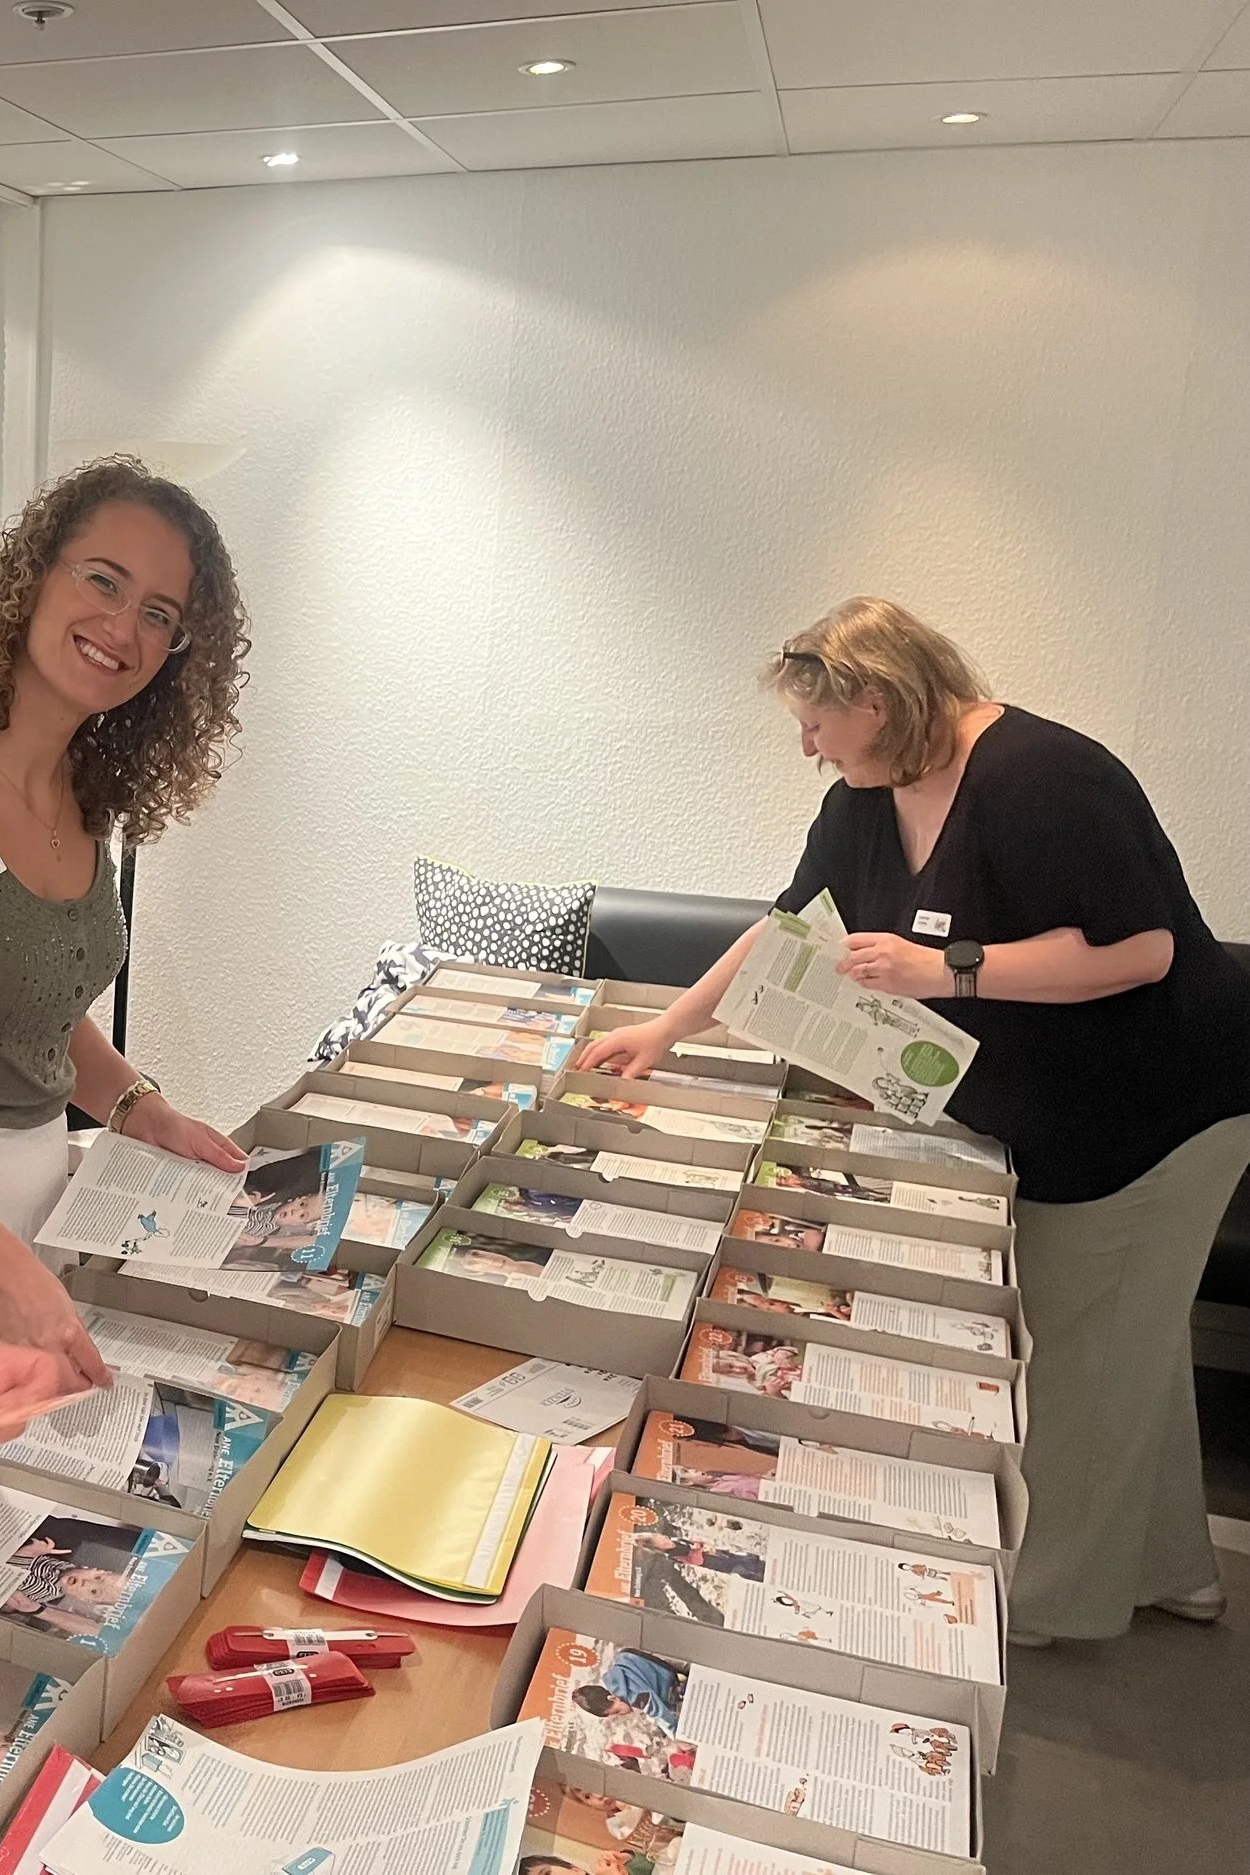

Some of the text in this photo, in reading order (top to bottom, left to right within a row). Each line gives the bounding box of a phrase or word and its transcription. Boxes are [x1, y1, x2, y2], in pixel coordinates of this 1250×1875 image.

[317, 1184, 339, 1236] Elternbrief
[301, 1248, 316, 1260] 11
[708, 1332, 723, 1342] 22
[668, 1423, 684, 1434] 21
[220, 1436, 232, 1456] ANE
[630, 1509, 647, 1523] 20
[614, 1529, 634, 1580] Elternbrief
[103, 1573, 149, 1630] Elternbrief
[568, 1647, 588, 1665] 19
[546, 1673, 571, 1738] Elternbrief
[23, 1713, 40, 1730] ANE
